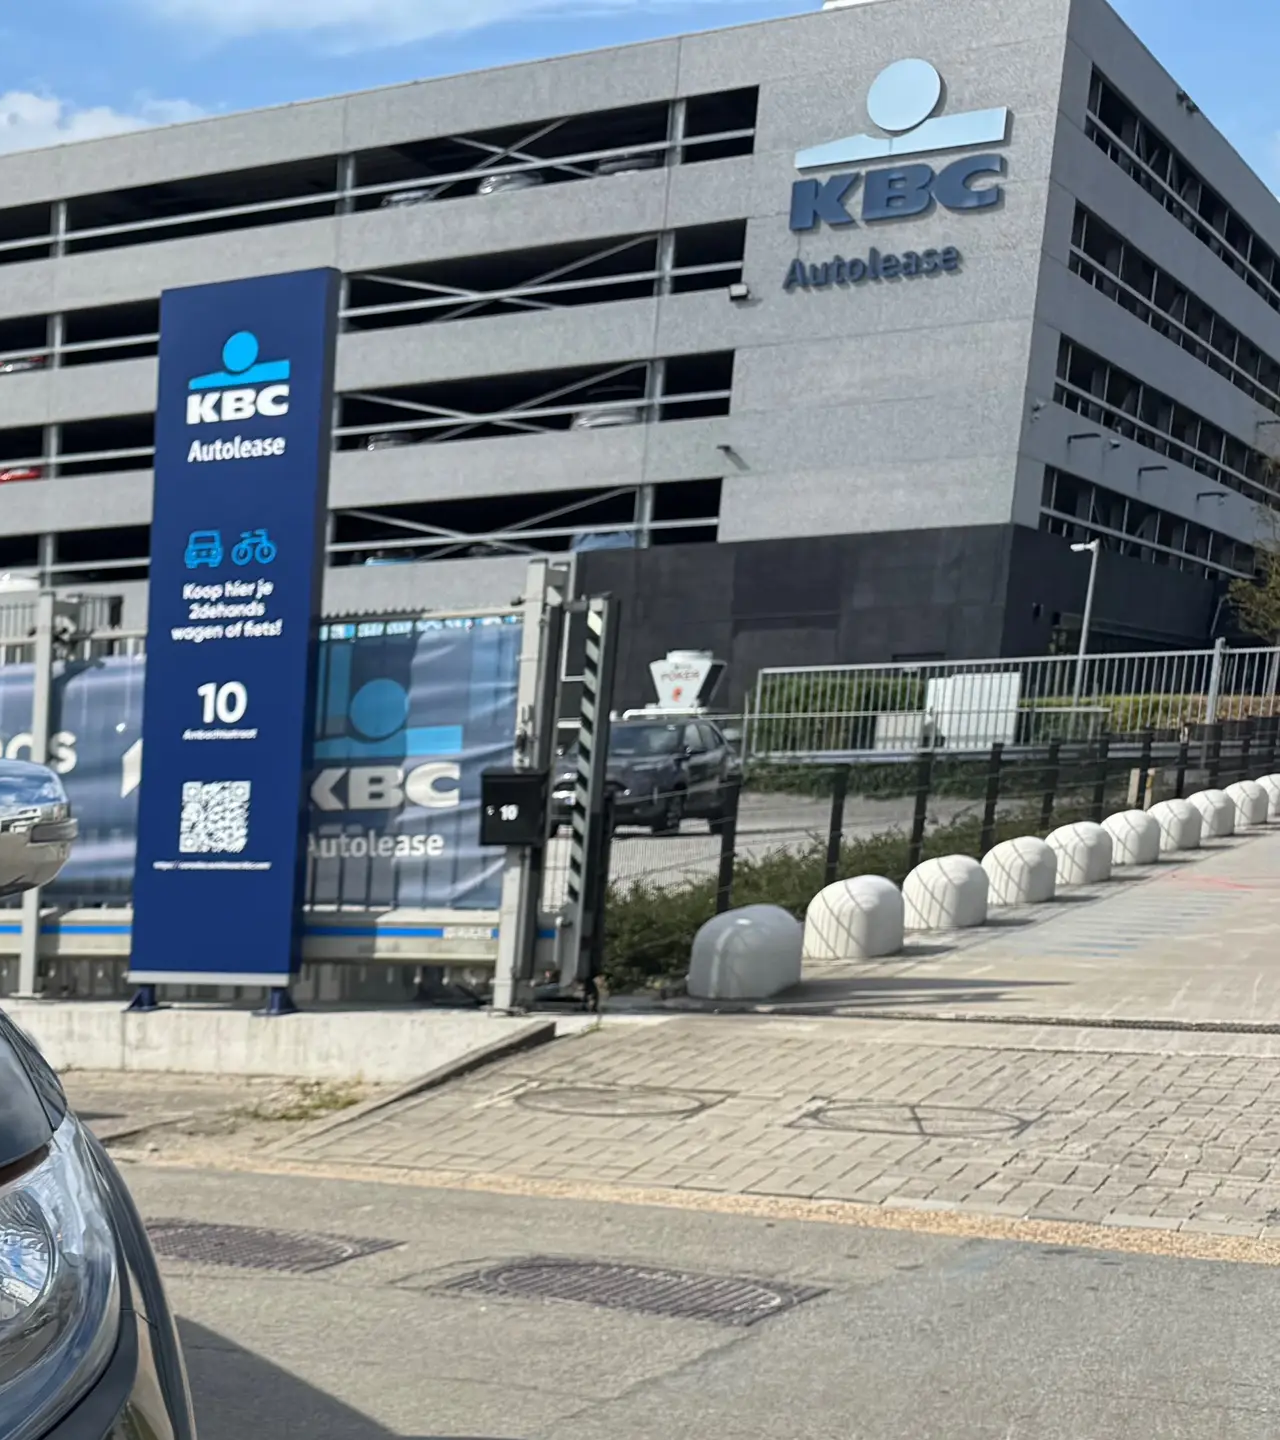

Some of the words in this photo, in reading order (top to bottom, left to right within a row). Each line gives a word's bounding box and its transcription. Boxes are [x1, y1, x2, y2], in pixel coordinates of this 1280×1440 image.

[790, 153, 1004, 231] KBC
[783, 246, 959, 290] Autolease
[186, 384, 289, 425] KBC
[187, 436, 286, 463] Autolease
[183, 583, 223, 601] Koop
[225, 580, 255, 597] hier
[256, 578, 274, 599] je
[189, 600, 266, 619] 2dehands
[171, 625, 223, 643] wagen
[225, 620, 243, 638] of
[197, 681, 248, 723] 10
[499, 804, 519, 821] 10
